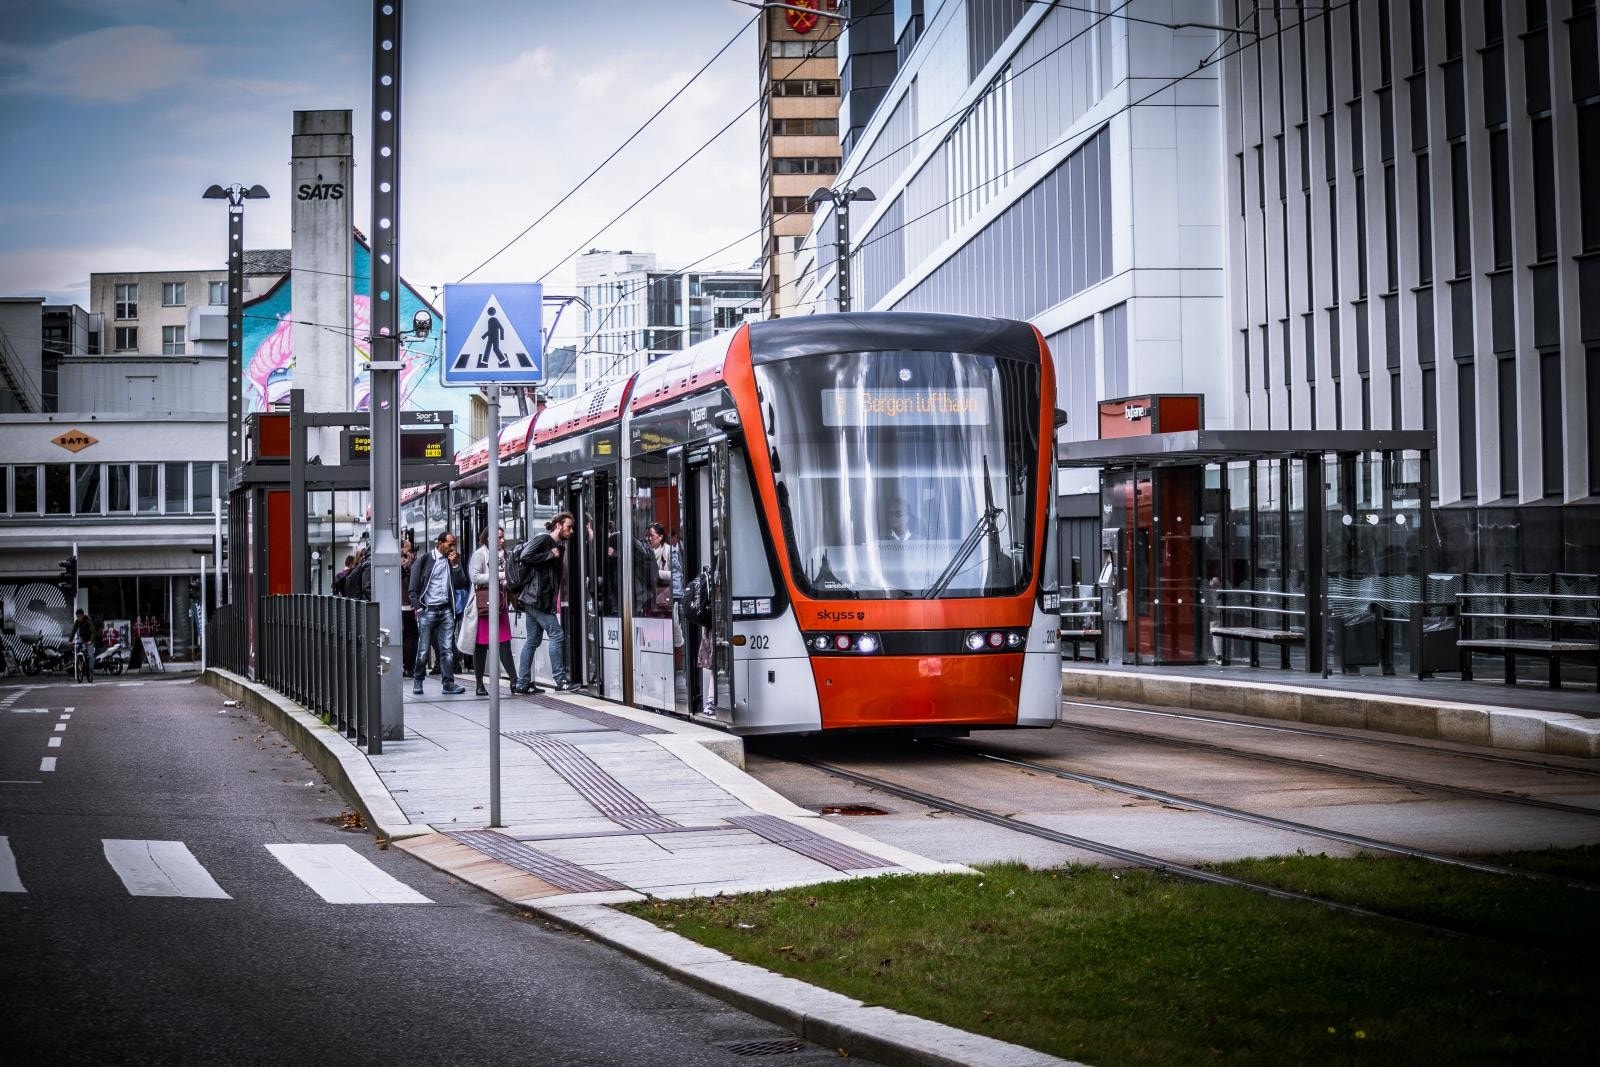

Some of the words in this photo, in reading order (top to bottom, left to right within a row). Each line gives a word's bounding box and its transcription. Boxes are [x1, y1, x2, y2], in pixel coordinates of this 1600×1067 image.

[297, 184, 344, 200] SATS
[863, 393, 912, 416] Bergen
[416, 412, 432, 420] Spor
[433, 412, 440, 421] 1
[817, 609, 855, 622] skyss
[750, 635, 770, 650] 202
